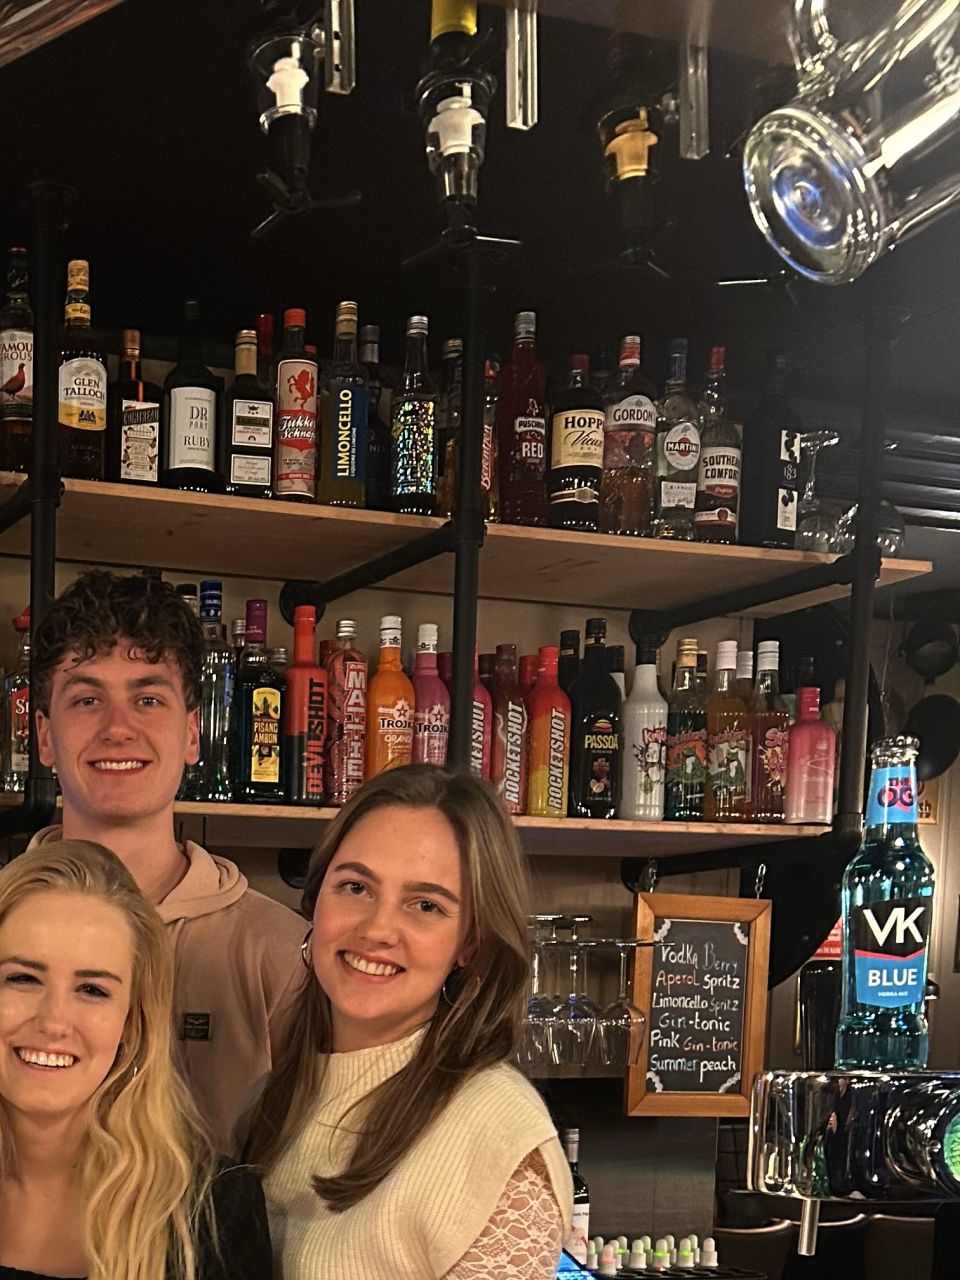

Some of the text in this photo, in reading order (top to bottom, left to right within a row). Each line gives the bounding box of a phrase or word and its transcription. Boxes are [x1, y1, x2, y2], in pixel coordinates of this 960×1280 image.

[74, 377, 100, 389] GLEN
[63, 386, 105, 401] TALLOCH
[190, 405, 208, 420] DR
[337, 389, 352, 476] LIMONCELLO
[564, 416, 604, 430] HOPP
[183, 435, 211, 449] RUBY
[522, 442, 544, 458] RED
[380, 717, 414, 729] TROJK
[416, 722, 449, 733] TROJK
[254, 732, 277, 744] AMBON
[504, 701, 524, 804] ROCKETSHOT
[548, 708, 565, 810] ROCKETSHOT
[862, 906, 926, 947] VK
[702, 943, 738, 976] Berry
[703, 974, 740, 995] Spritz
[867, 968, 918, 987] BLUE
[652, 993, 739, 1017] Limoncello Spritz
[658, 1012, 731, 1032] Gin-tonic
[650, 1054, 736, 1083] Summer peach
